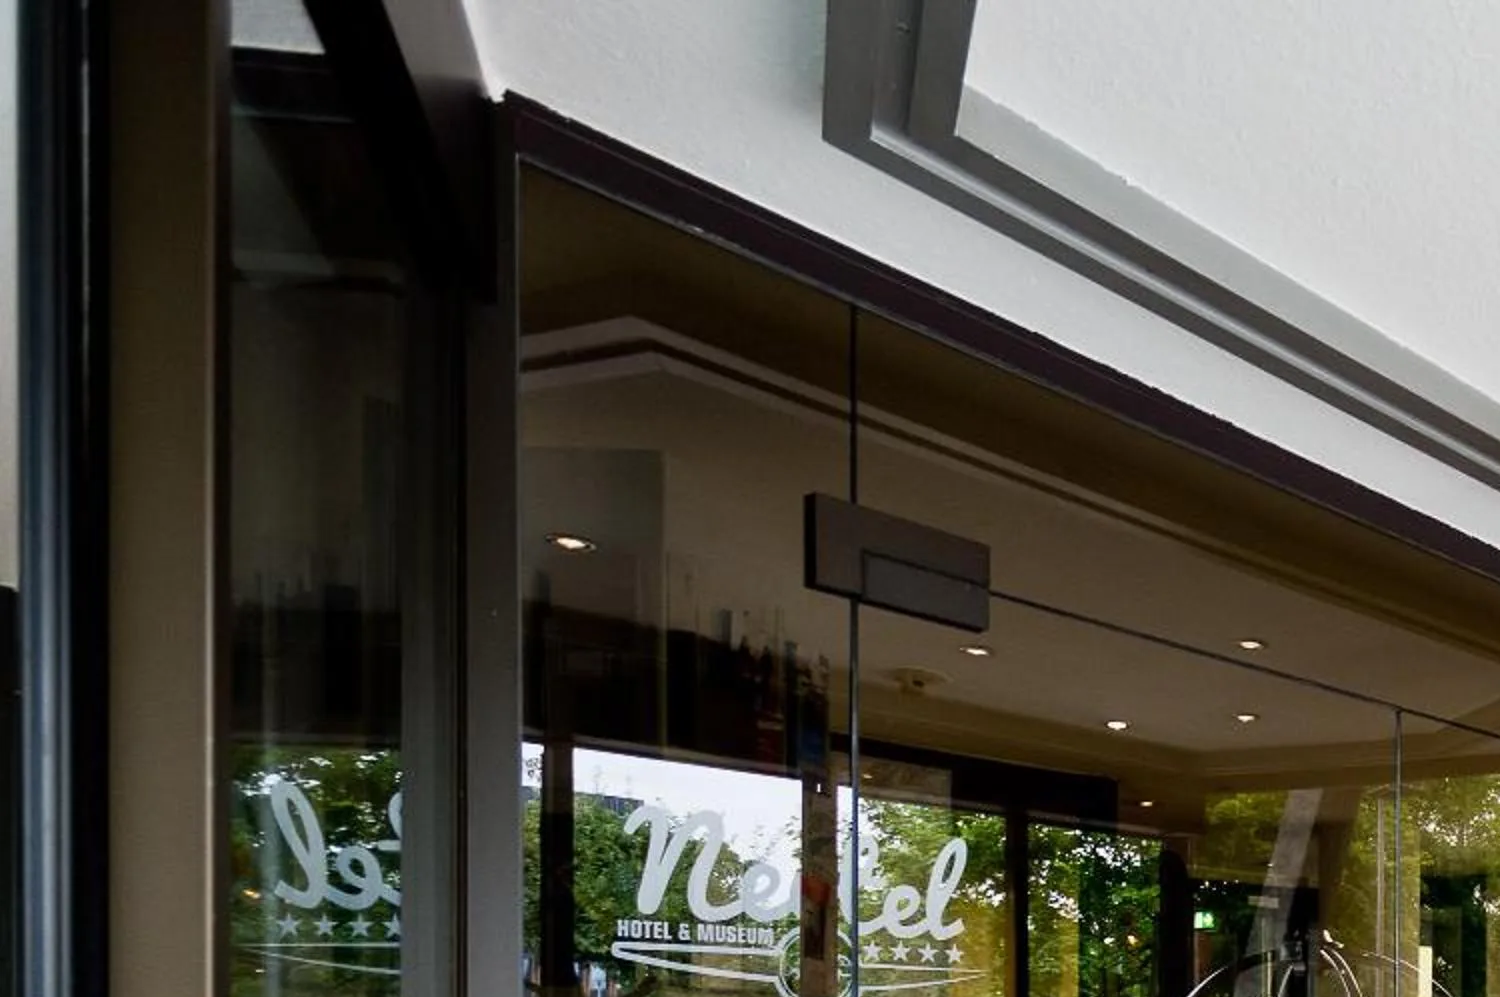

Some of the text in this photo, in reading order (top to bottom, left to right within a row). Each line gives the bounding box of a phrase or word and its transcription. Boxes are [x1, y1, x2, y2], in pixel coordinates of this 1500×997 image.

[623, 805, 968, 941] Netel
[616, 918, 775, 946] HOTEL & MUSEUM
